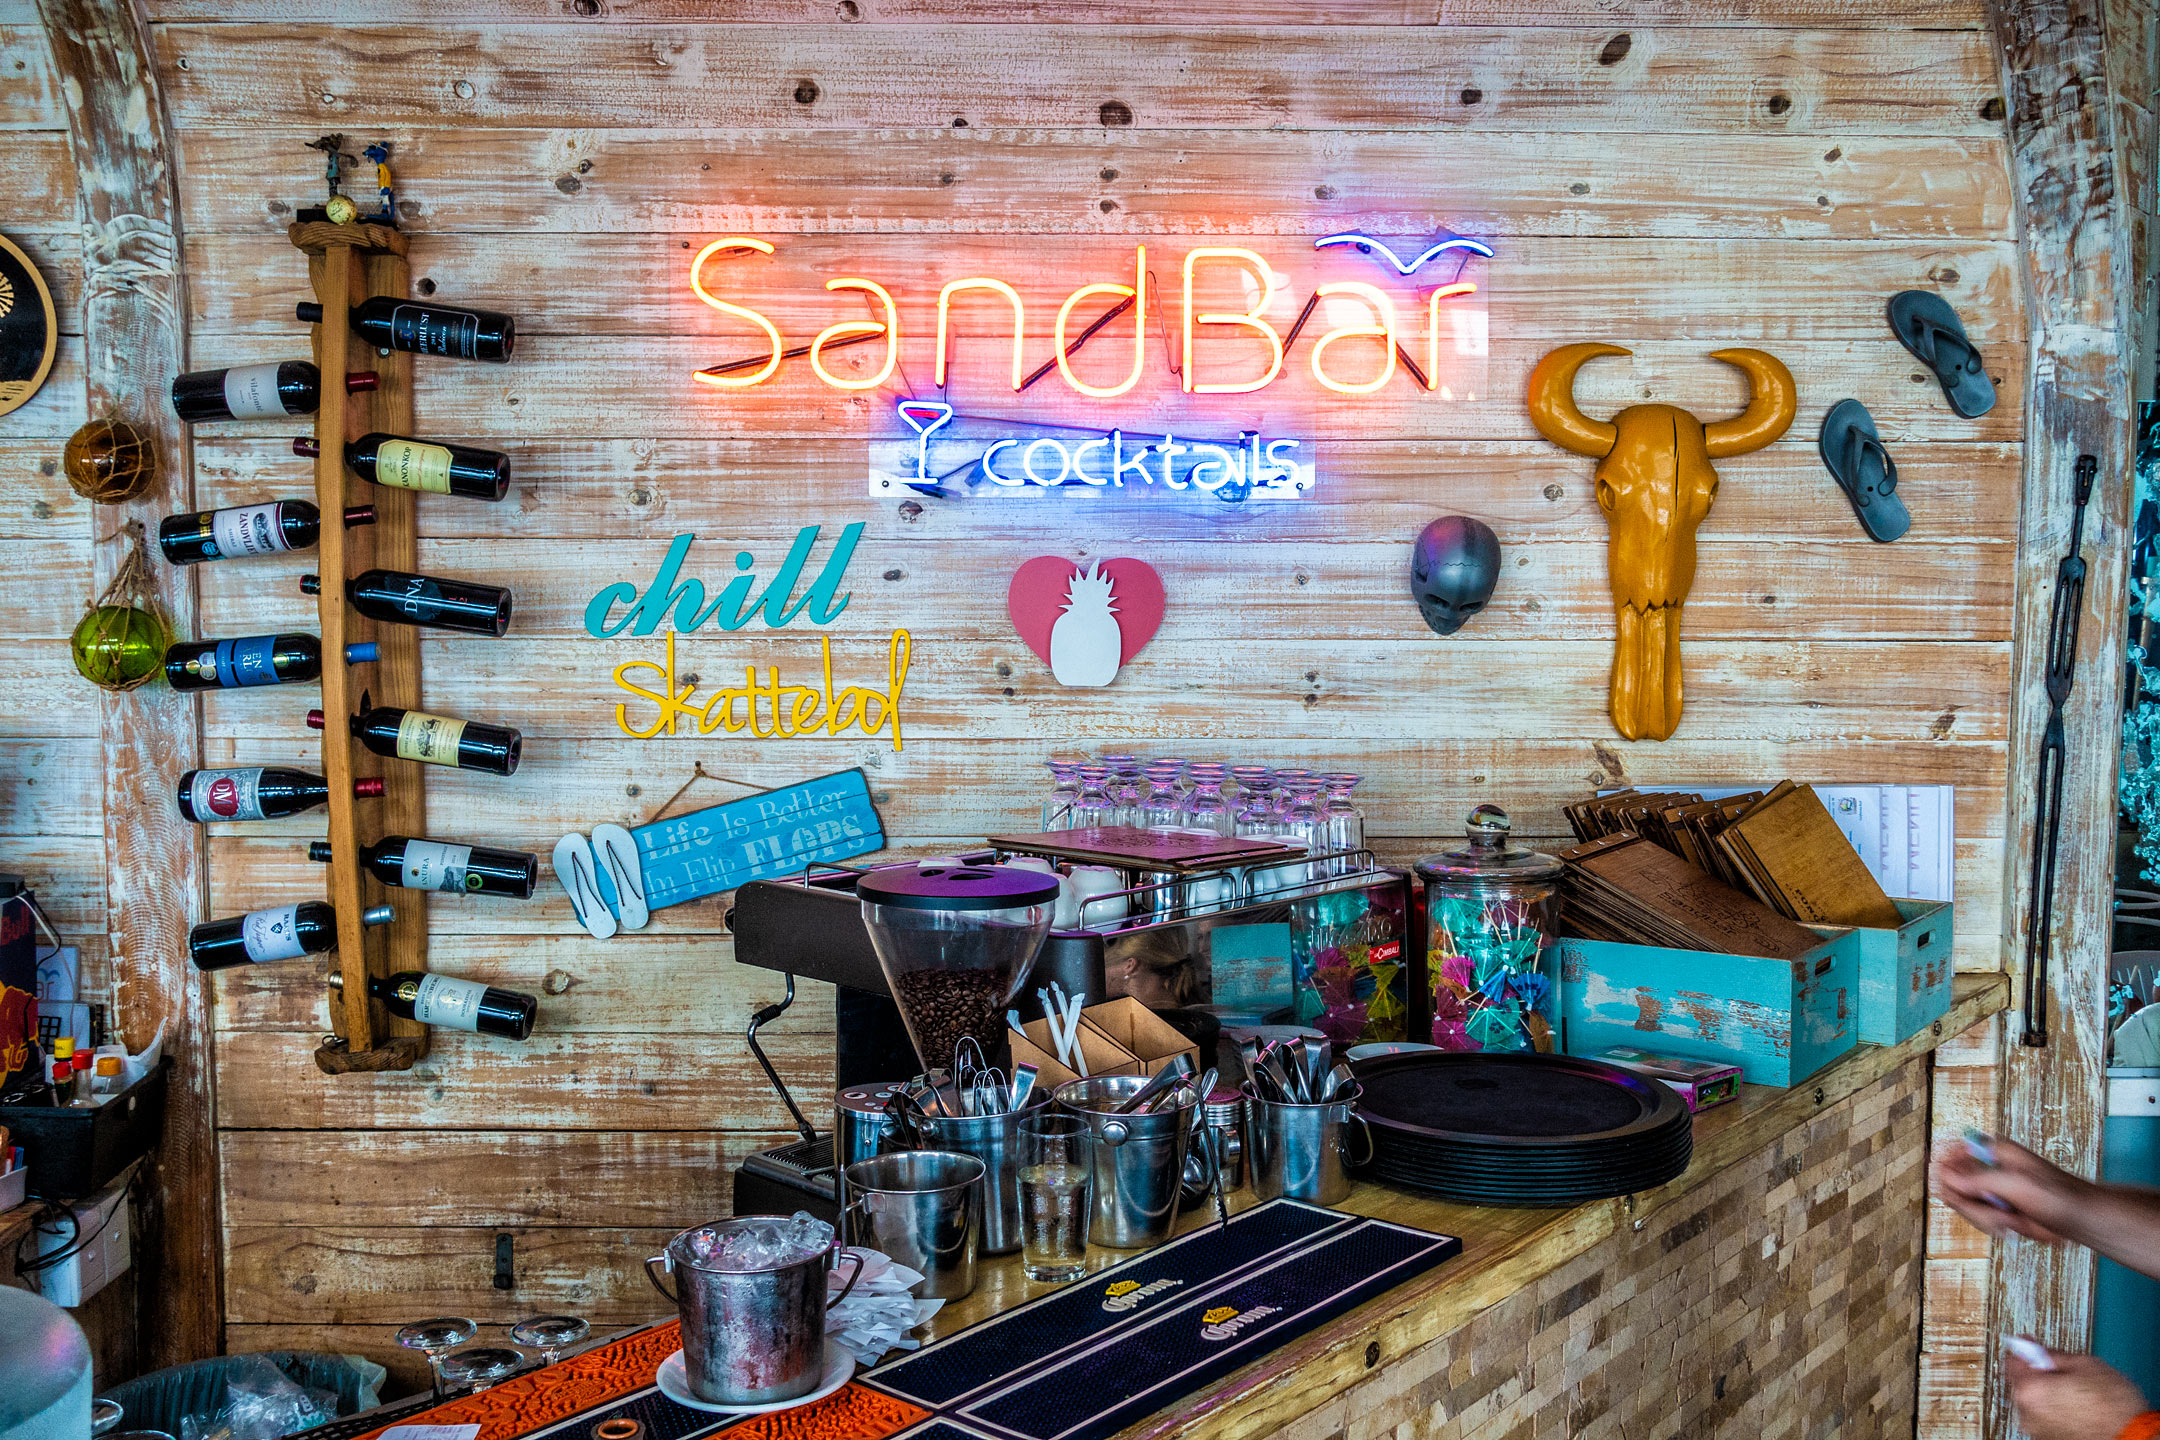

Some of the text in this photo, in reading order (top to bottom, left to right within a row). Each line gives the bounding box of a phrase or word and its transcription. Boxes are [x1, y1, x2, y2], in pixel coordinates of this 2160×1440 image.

[400, 446, 412, 487] KANONKOP
[982, 429, 1300, 489] cocktails
[404, 578, 425, 614] DNA
[584, 521, 866, 639] chill
[641, 789, 848, 860] Life Is Better
[421, 857, 430, 886] ANURA
[645, 814, 865, 900] In Flip FLOPS
[0, 904, 31, 947] Bull
